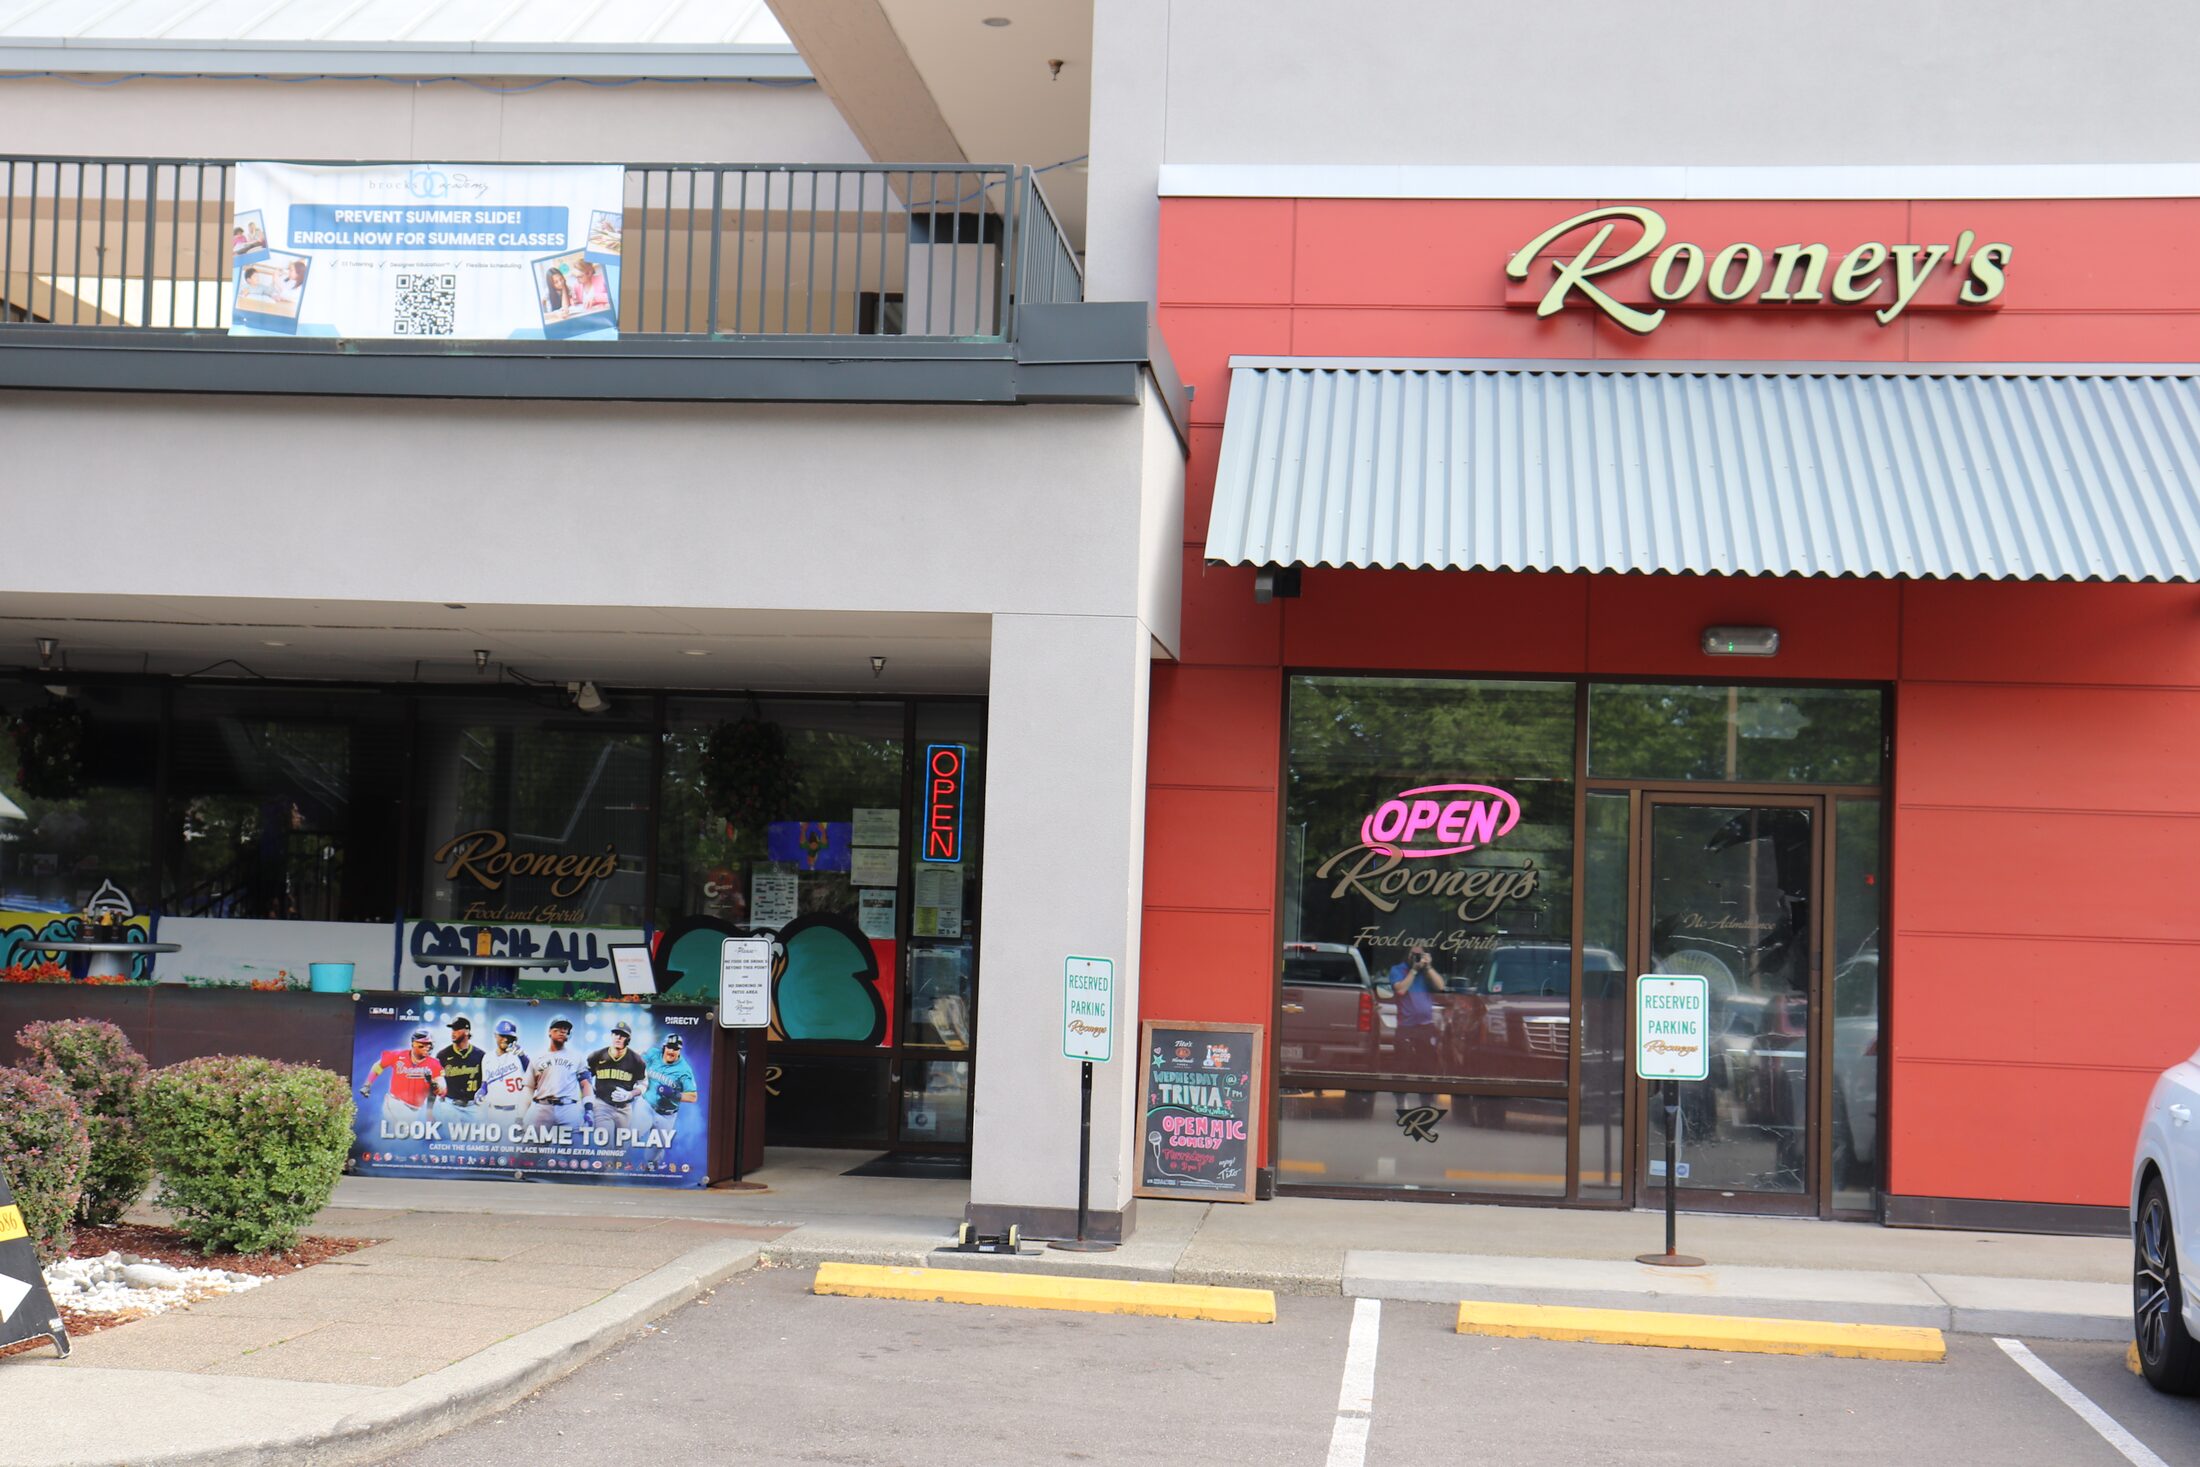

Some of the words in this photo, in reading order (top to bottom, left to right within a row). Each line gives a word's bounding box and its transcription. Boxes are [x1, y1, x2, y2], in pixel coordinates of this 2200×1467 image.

[334, 209, 404, 224] PREVENT
[405, 210, 472, 225] SUMMER
[474, 211, 521, 225] SLIDE!
[293, 231, 351, 245] ENROLL
[353, 232, 395, 245] NOW
[398, 232, 426, 246] FOR
[428, 232, 495, 246] SUMMER
[498, 233, 565, 247] CLASSES
[1505, 205, 2013, 335] Rooney's
[930, 751, 959, 857] OPEN
[1372, 800, 1503, 843] OPEN
[433, 829, 618, 898] Rooney's
[1315, 842, 1539, 922] Rooney's
[464, 901, 503, 921] Food
[504, 906, 534, 921] and
[535, 903, 585, 924] Spirits
[1353, 926, 1406, 949] Food
[1403, 931, 1443, 949] and
[1439, 930, 1499, 953] Spirits
[542, 929, 610, 973] ALL
[1069, 974, 1109, 991] RESERVED
[1071, 1000, 1106, 1017] PARKING
[1645, 995, 1700, 1010] RESERVED
[664, 1016, 700, 1025] DIRECTV
[1648, 1020, 1697, 1035] PARKING
[554, 1058, 574, 1070] YORK
[596, 1068, 611, 1080] SAN
[611, 1069, 633, 1082] DIEGO
[1152, 1070, 1219, 1086] WEDNESDAY
[1159, 1084, 1223, 1107] TRIVIA
[1224, 1087, 1231, 1097] 7
[1232, 1090, 1243, 1098] PM
[1162, 1115, 1208, 1136] OPEN
[1210, 1119, 1247, 1140] MIC
[1397, 1106, 1440, 1143] R
[380, 1119, 442, 1141] LOOK
[448, 1121, 501, 1142] WHO
[508, 1123, 573, 1145] CAME
[579, 1126, 610, 1146] TO
[616, 1128, 677, 1149] PLAY
[1169, 1135, 1223, 1149] COMEDY
[429, 1143, 451, 1151] CATCH
[573, 1148, 595, 1156] EXTRA
